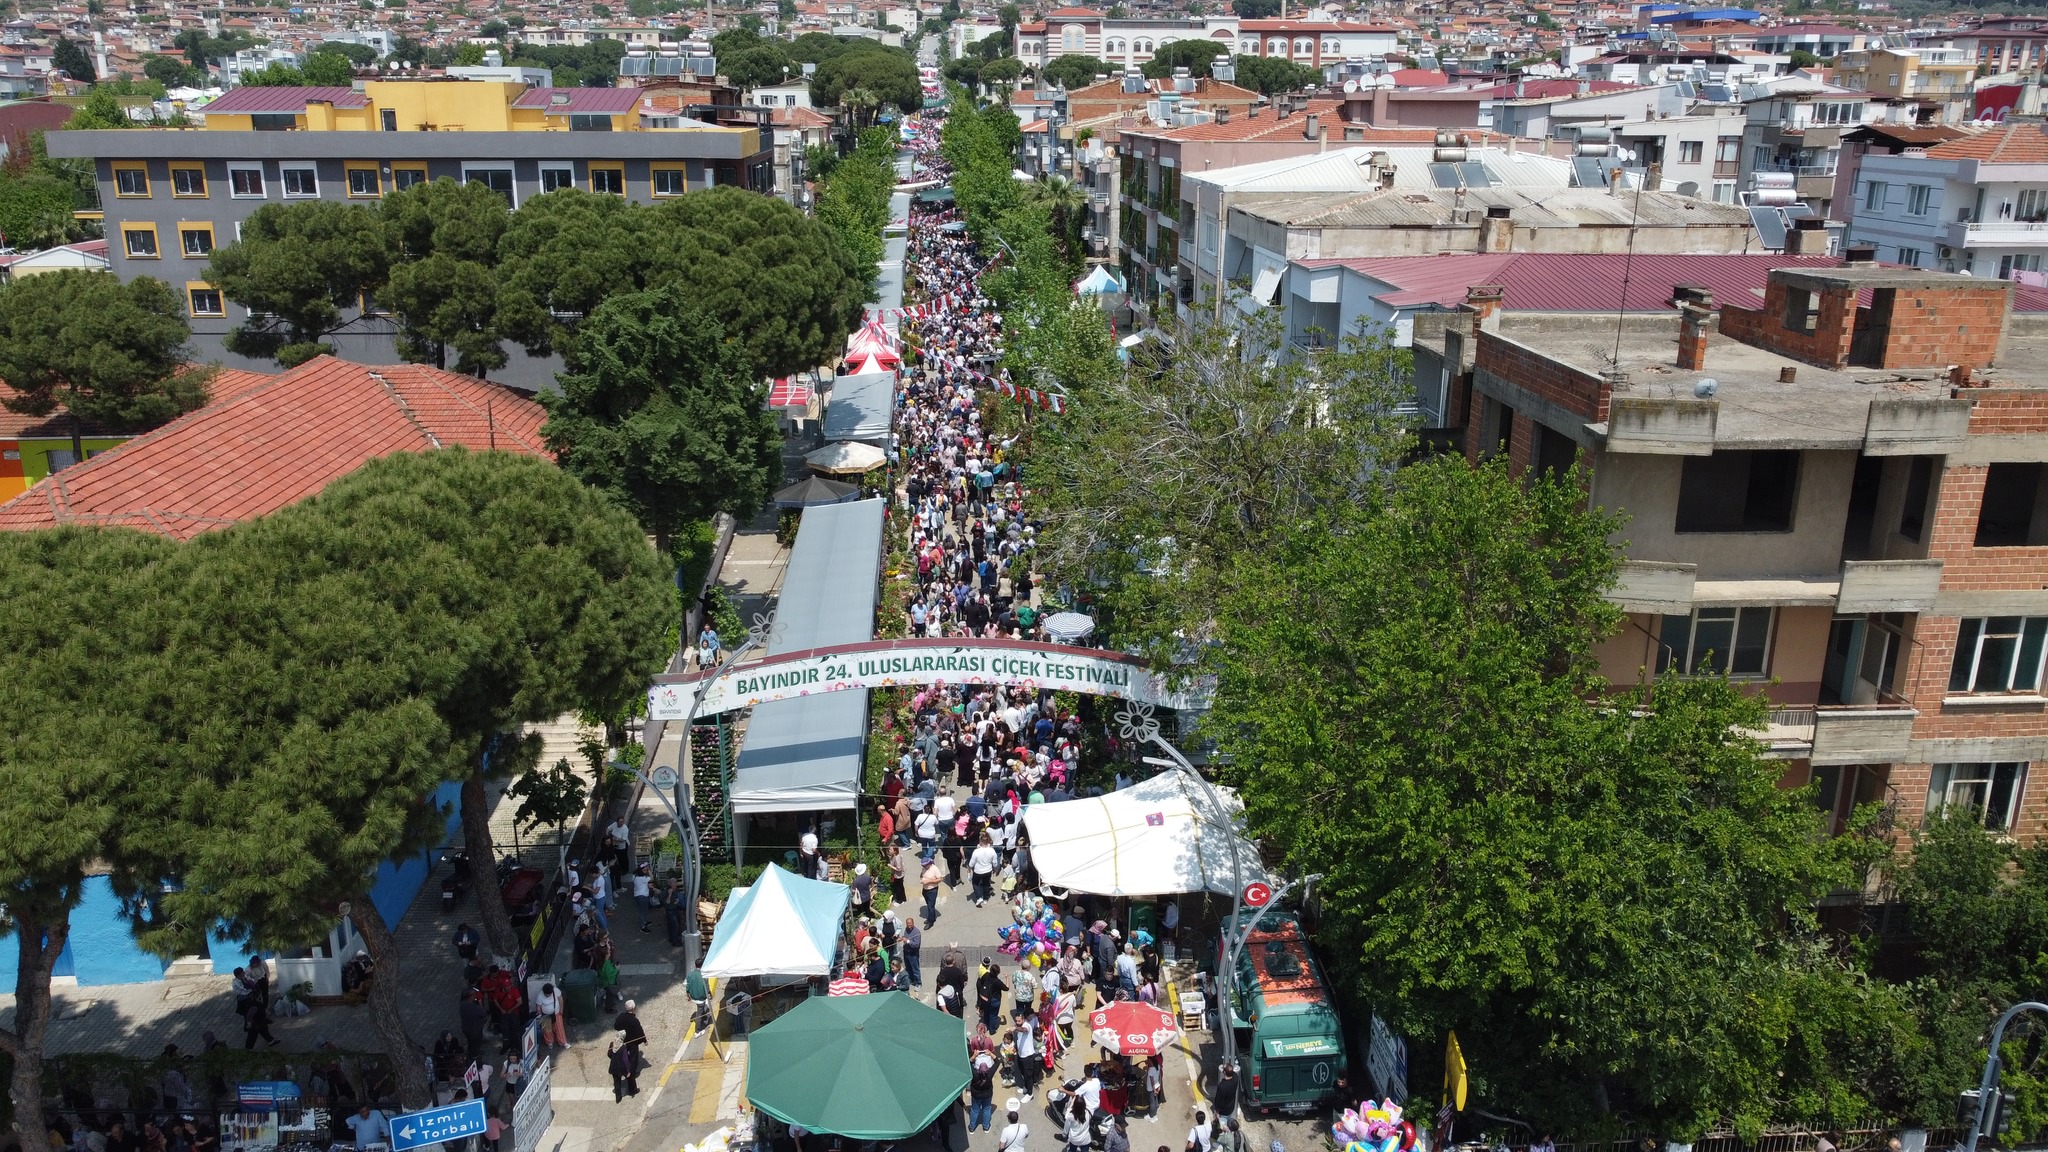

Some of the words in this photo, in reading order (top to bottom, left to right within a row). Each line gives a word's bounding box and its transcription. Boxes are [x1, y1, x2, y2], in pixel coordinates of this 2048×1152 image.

[737, 668, 820, 695] BAYINDIR
[825, 664, 852, 681] 24.
[858, 656, 985, 677] ULUSLARARASI
[992, 655, 1040, 677] ÇİÇEK
[1046, 663, 1129, 687] FESTİVALİ
[1296, 1039, 1323, 1050] NEREYE
[466, 1064, 476, 1083] WC
[516, 1074, 544, 1118] Belediye
[419, 1111, 466, 1127] İzmir
[422, 1120, 480, 1140] Torbalı
